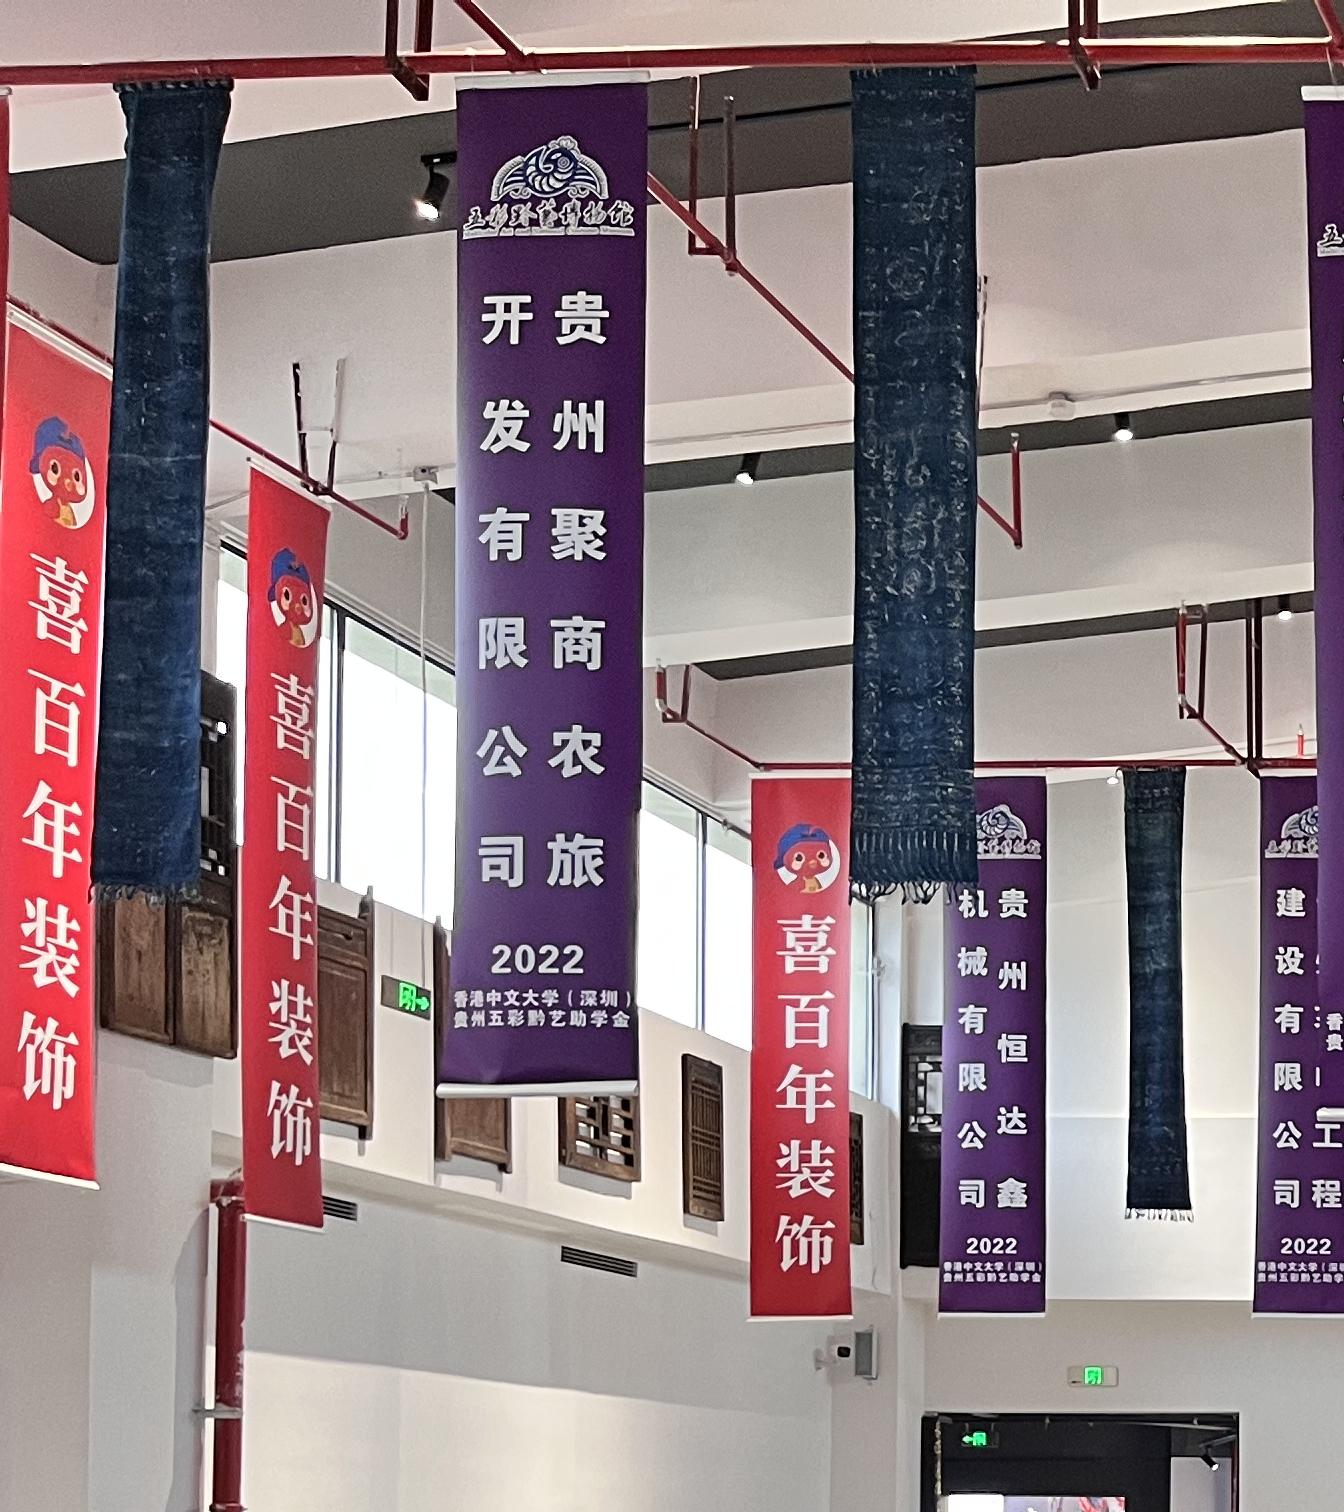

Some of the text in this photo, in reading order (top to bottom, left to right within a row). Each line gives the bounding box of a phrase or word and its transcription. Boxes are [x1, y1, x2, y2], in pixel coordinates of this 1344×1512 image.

[476, 295, 534, 888] 开发有限公司
[547, 291, 610, 888] 贵州聚商农旅
[17, 552, 89, 1110] 喜百年装饰
[267, 672, 314, 1166] 喜百年装饰
[491, 944, 584, 974] 2022
[776, 914, 837, 1274] 喜百年装饰
[957, 888, 989, 1208] 机械有限公司
[997, 888, 1029, 1208] 贵州恒达鑫
[1273, 887, 1306, 1209] 建设有限公司
[966, 1237, 1017, 1255] 2022
[1280, 1237, 1332, 1255] 2022
